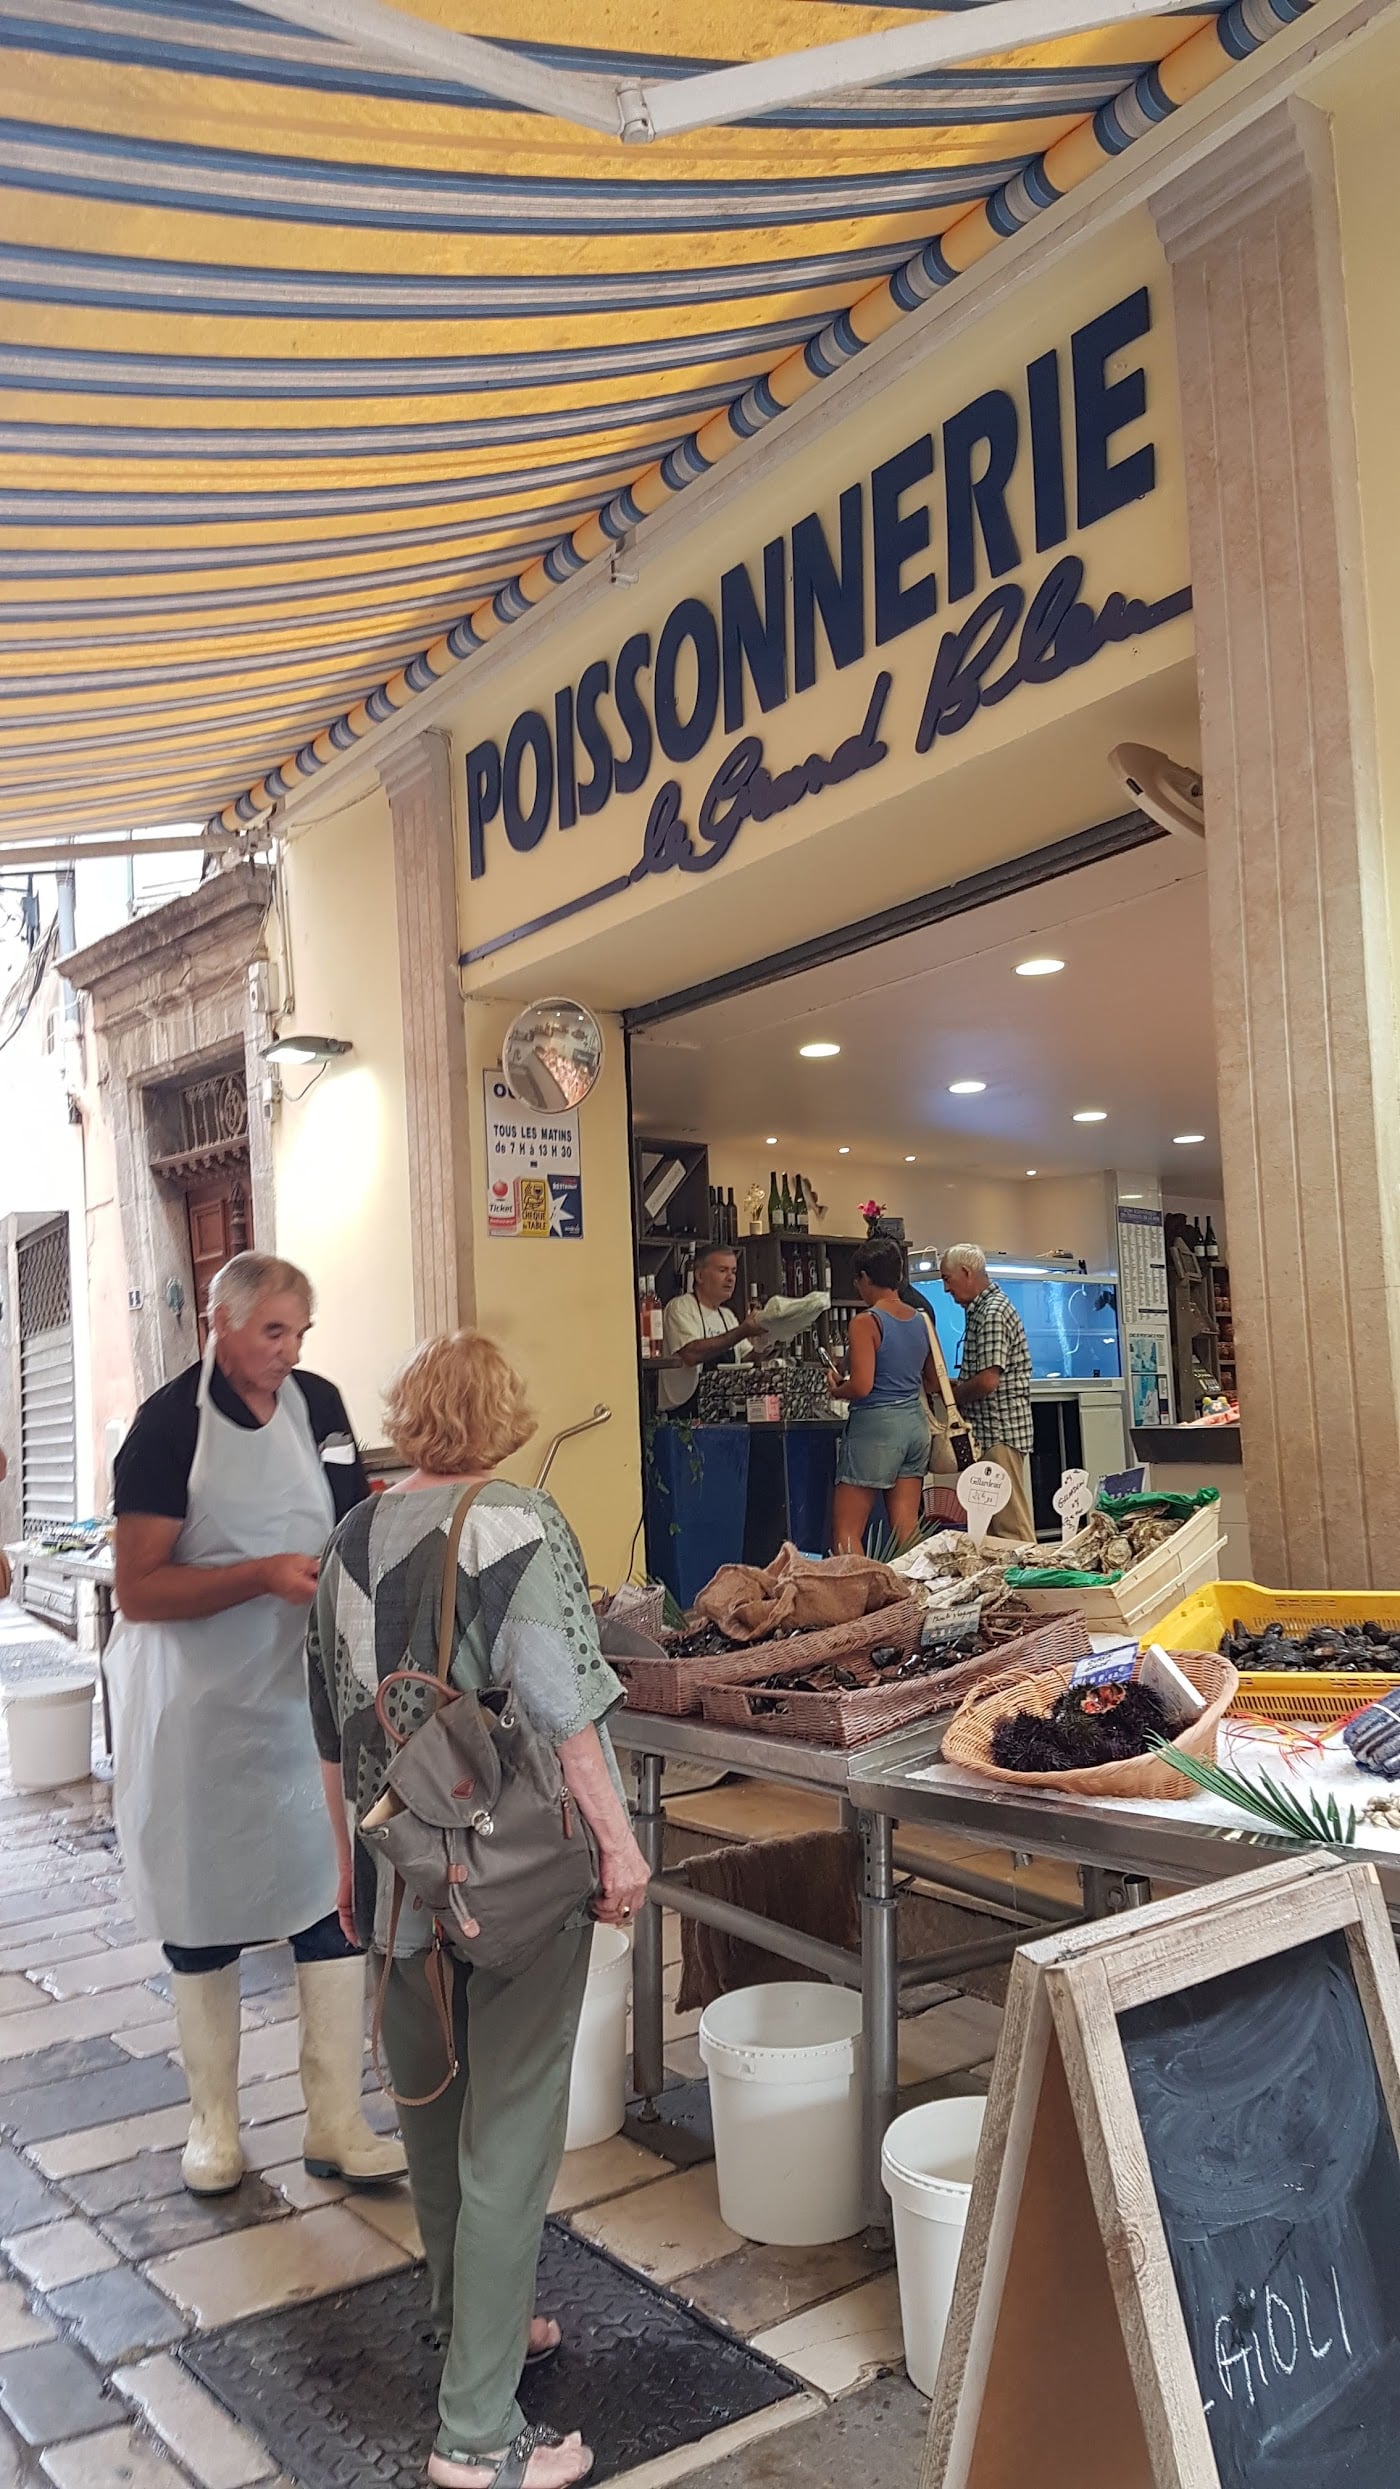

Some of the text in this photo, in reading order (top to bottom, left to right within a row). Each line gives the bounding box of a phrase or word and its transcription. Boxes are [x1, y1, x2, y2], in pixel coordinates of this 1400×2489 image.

[465, 286, 1155, 879] POISSONNERIE
[494, 1124, 572, 1142] TOUS LES MATINS
[495, 1141, 506, 1154] de
[510, 1142, 515, 1154] 7
[529, 1144, 535, 1156] à
[539, 1144, 548, 1156] 13
[561, 1146, 572, 1158] 30
[489, 1203, 513, 1213] Ticket
[528, 1221, 546, 1230] TABLE
